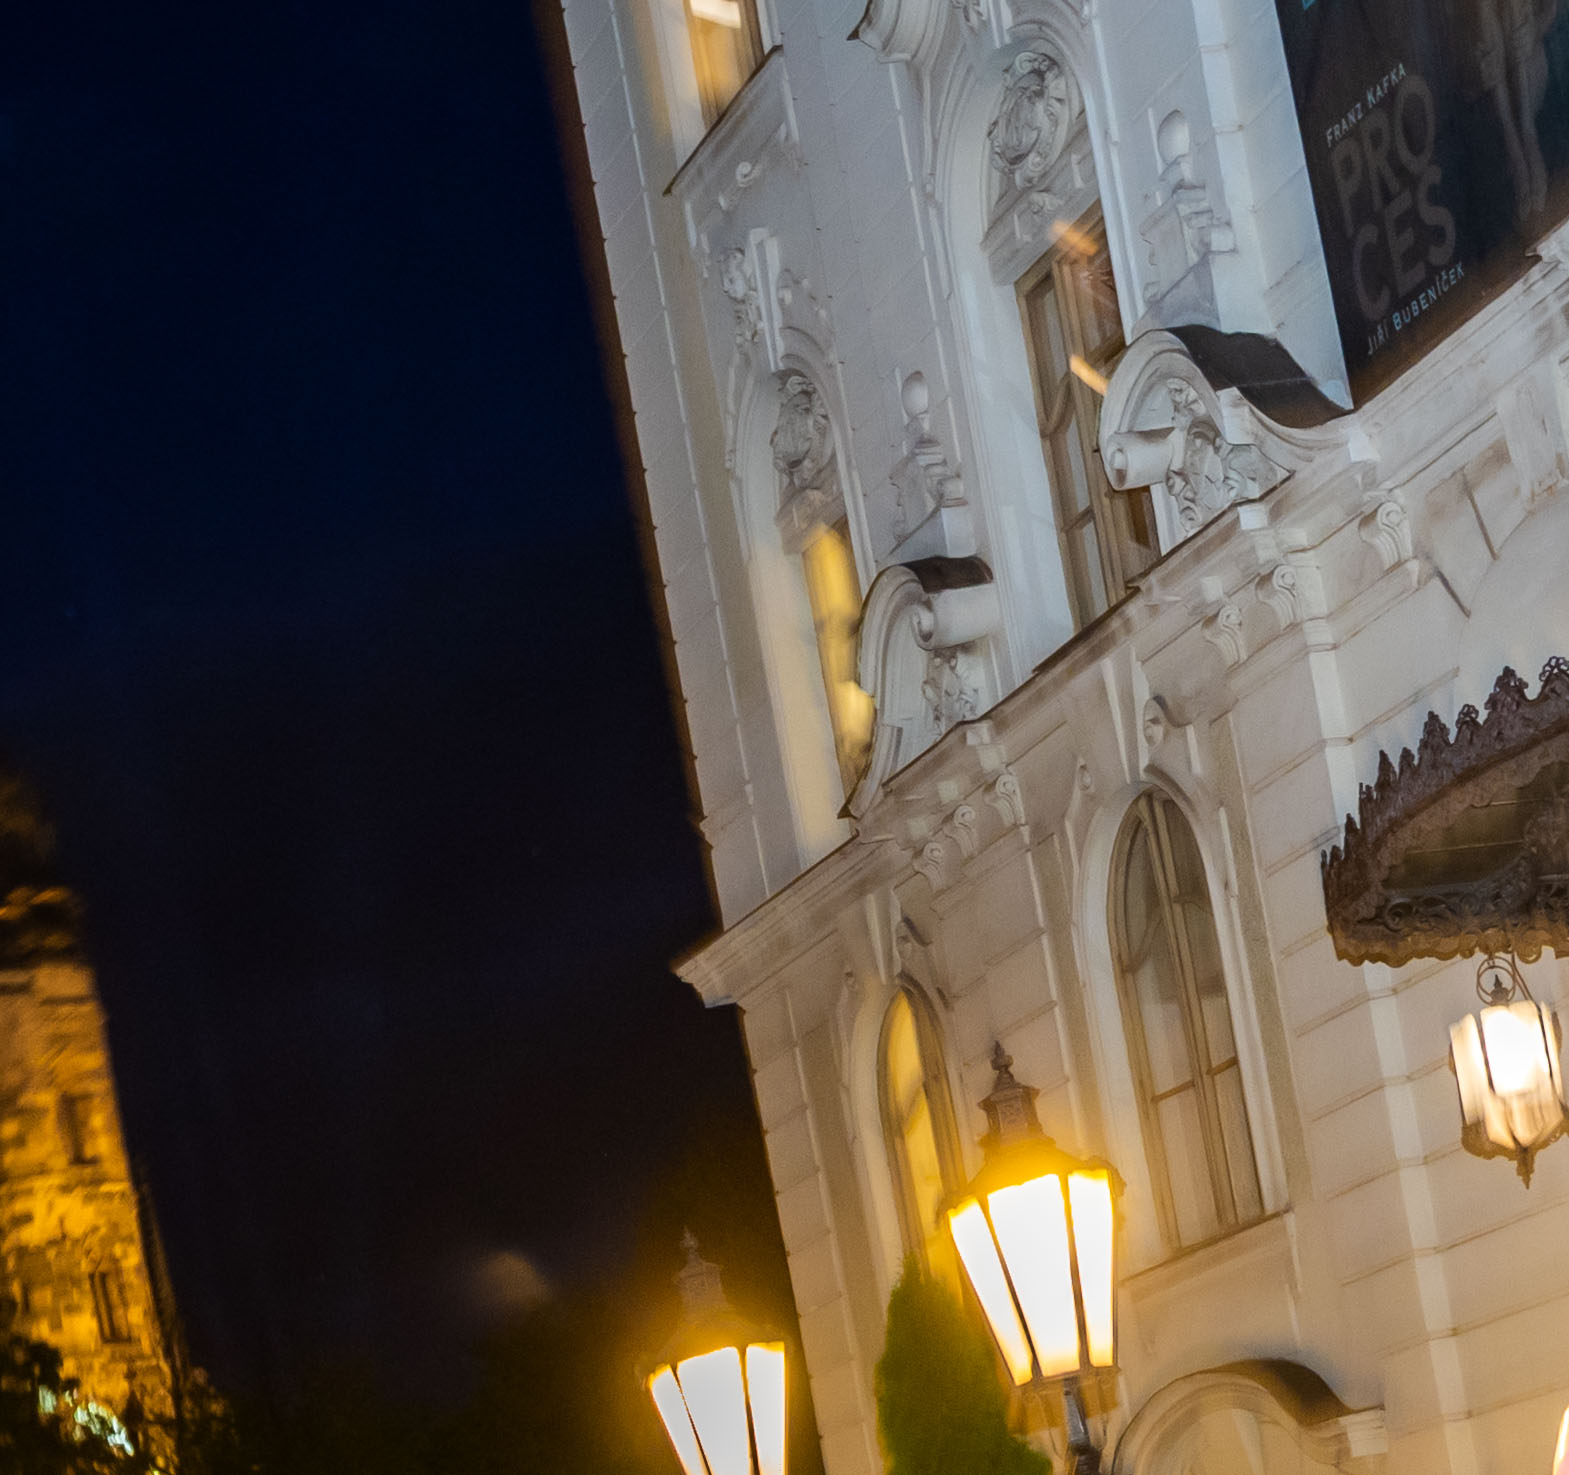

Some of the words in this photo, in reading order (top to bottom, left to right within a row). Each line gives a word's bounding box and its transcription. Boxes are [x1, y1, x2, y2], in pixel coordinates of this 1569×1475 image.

[1326, 101, 1364, 149] FRANZ
[1366, 62, 1407, 109] KAFKA
[1331, 74, 1436, 238] PRO
[1352, 163, 1456, 322] CES
[1392, 261, 1465, 332] BUBENÍČEK
